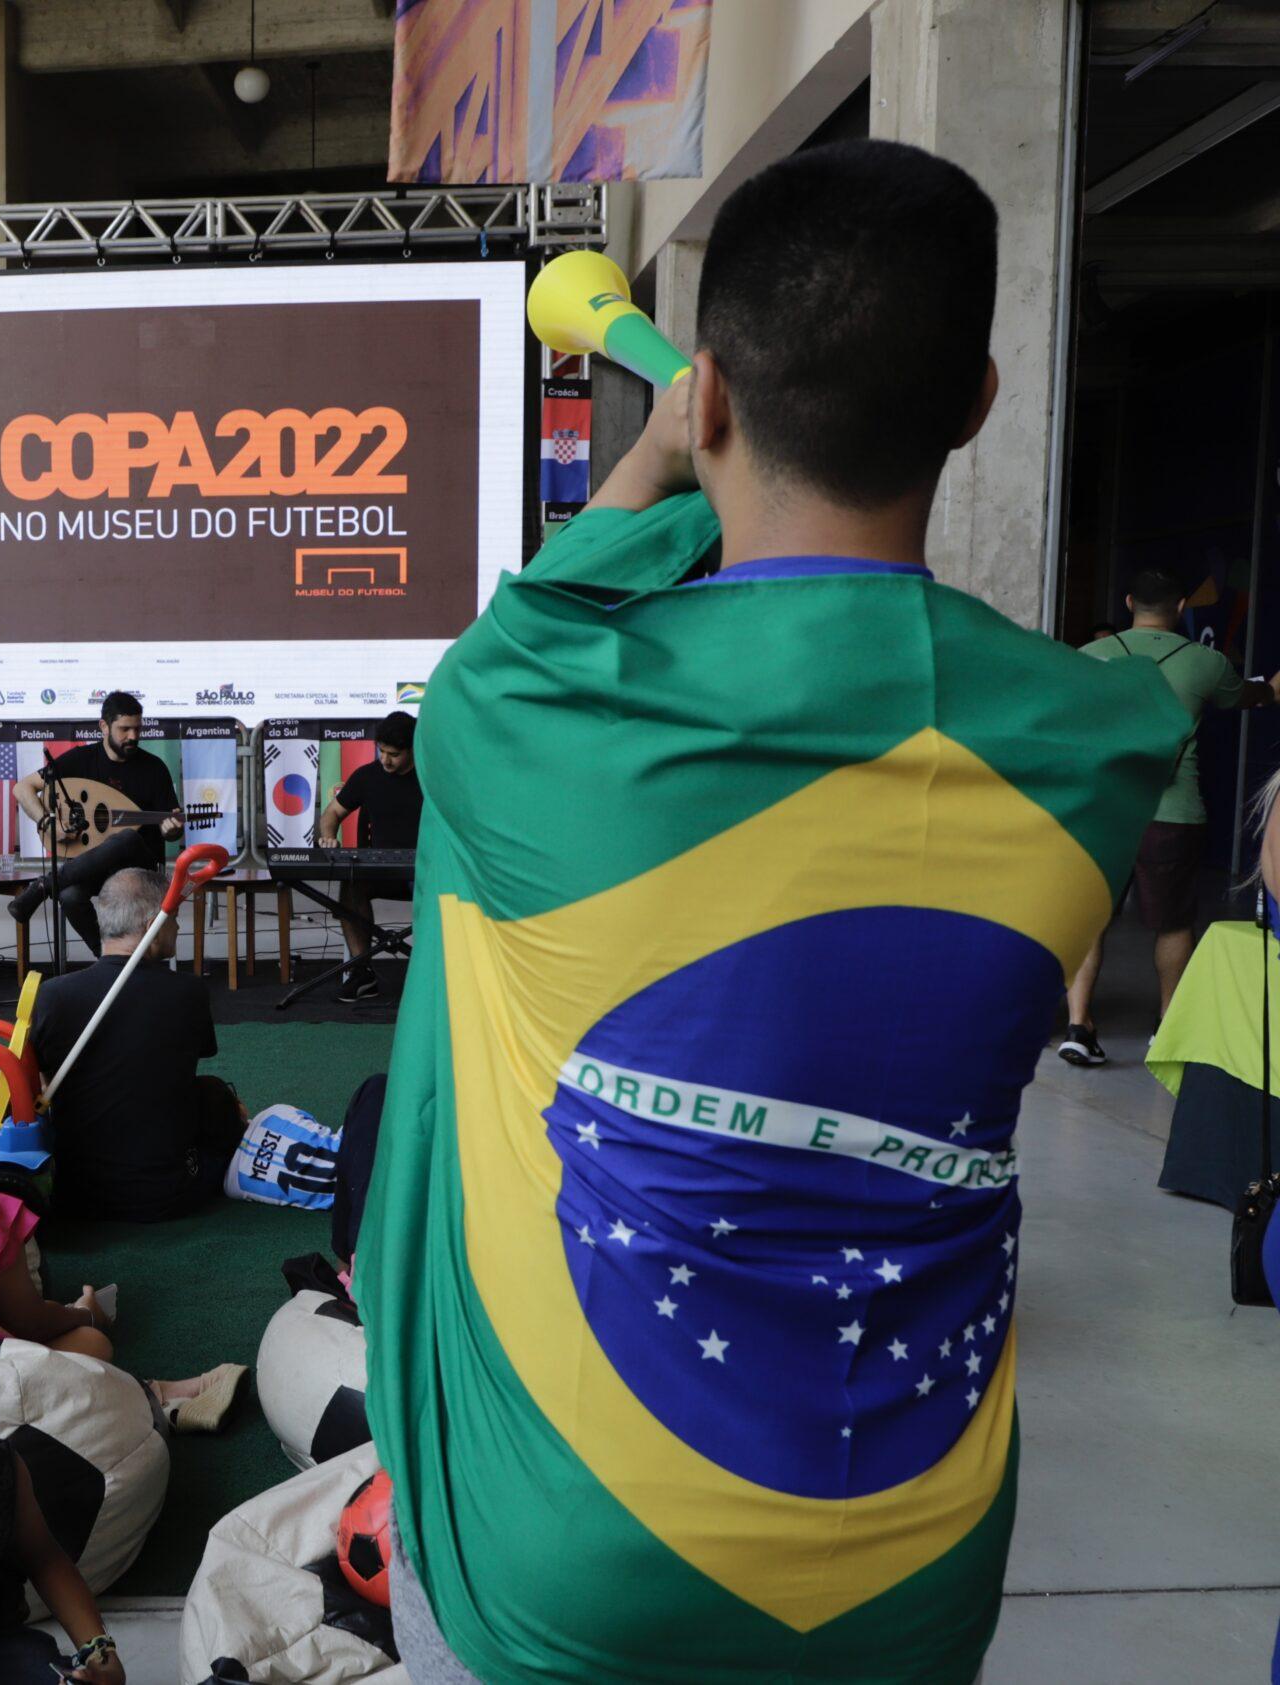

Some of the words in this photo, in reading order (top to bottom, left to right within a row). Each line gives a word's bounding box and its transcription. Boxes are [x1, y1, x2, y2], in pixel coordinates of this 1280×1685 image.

[548, 387, 579, 397] Croácia
[549, 511, 572, 520] Brasil
[0, 512, 47, 541] NO
[58, 509, 178, 541] MUSEU
[190, 508, 237, 538] DO
[248, 505, 407, 538] FUTEBOL
[295, 589, 334, 597] MUSEU
[358, 588, 407, 596] FUTEBOL
[196, 689, 218, 700] SÃO
[220, 690, 255, 700] PAULO
[21, 730, 54, 739] Polônia
[186, 727, 230, 737] Argentina
[268, 727, 282, 737] do
[283, 727, 299, 737] Sul
[324, 729, 365, 739] Portugal
[280, 854, 310, 862] YAMAHA
[577, 1063, 768, 1137] ORDEM
[810, 1117, 840, 1149] E
[249, 1130, 282, 1182] MESSI
